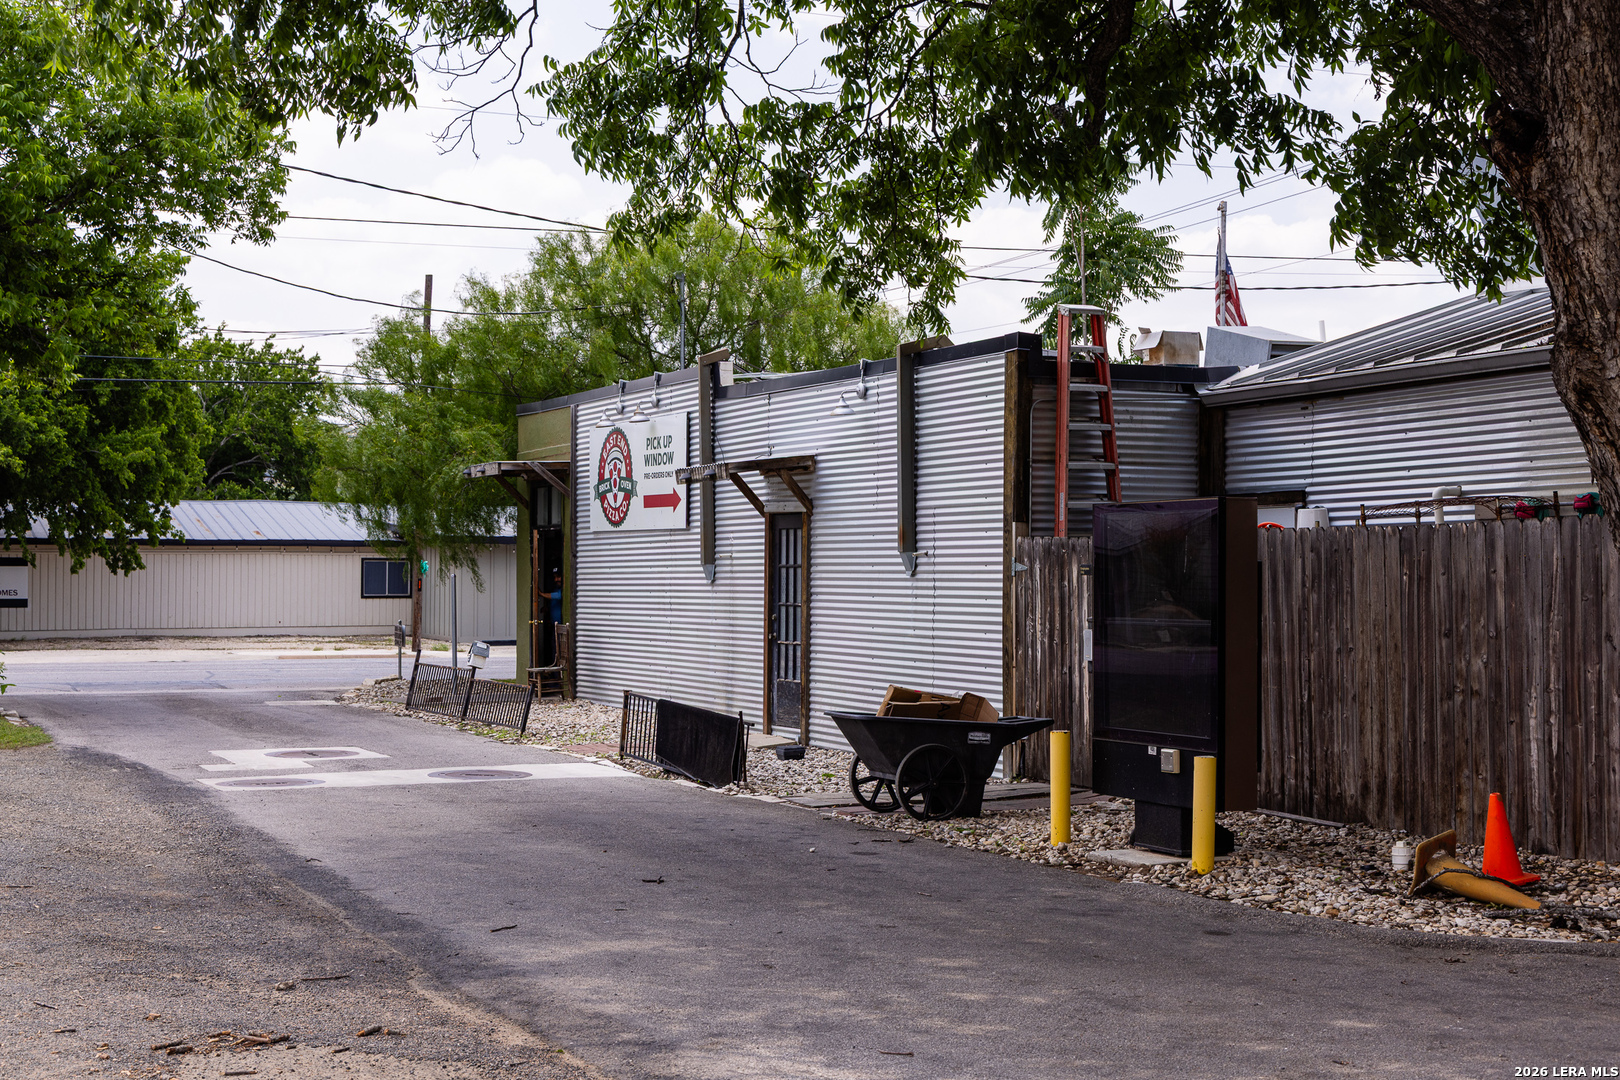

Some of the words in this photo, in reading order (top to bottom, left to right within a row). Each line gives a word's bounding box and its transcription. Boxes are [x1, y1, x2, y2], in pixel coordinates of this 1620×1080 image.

[603, 434, 616, 460] EAST
[617, 434, 628, 456] END
[646, 437, 662, 450] PICK
[663, 435, 673, 449] UP
[643, 451, 674, 467] WINDOW
[665, 470, 674, 478] ONLY
[598, 481, 610, 493] BRICK
[621, 480, 632, 490] OVEN
[603, 499, 619, 521] PIZZA
